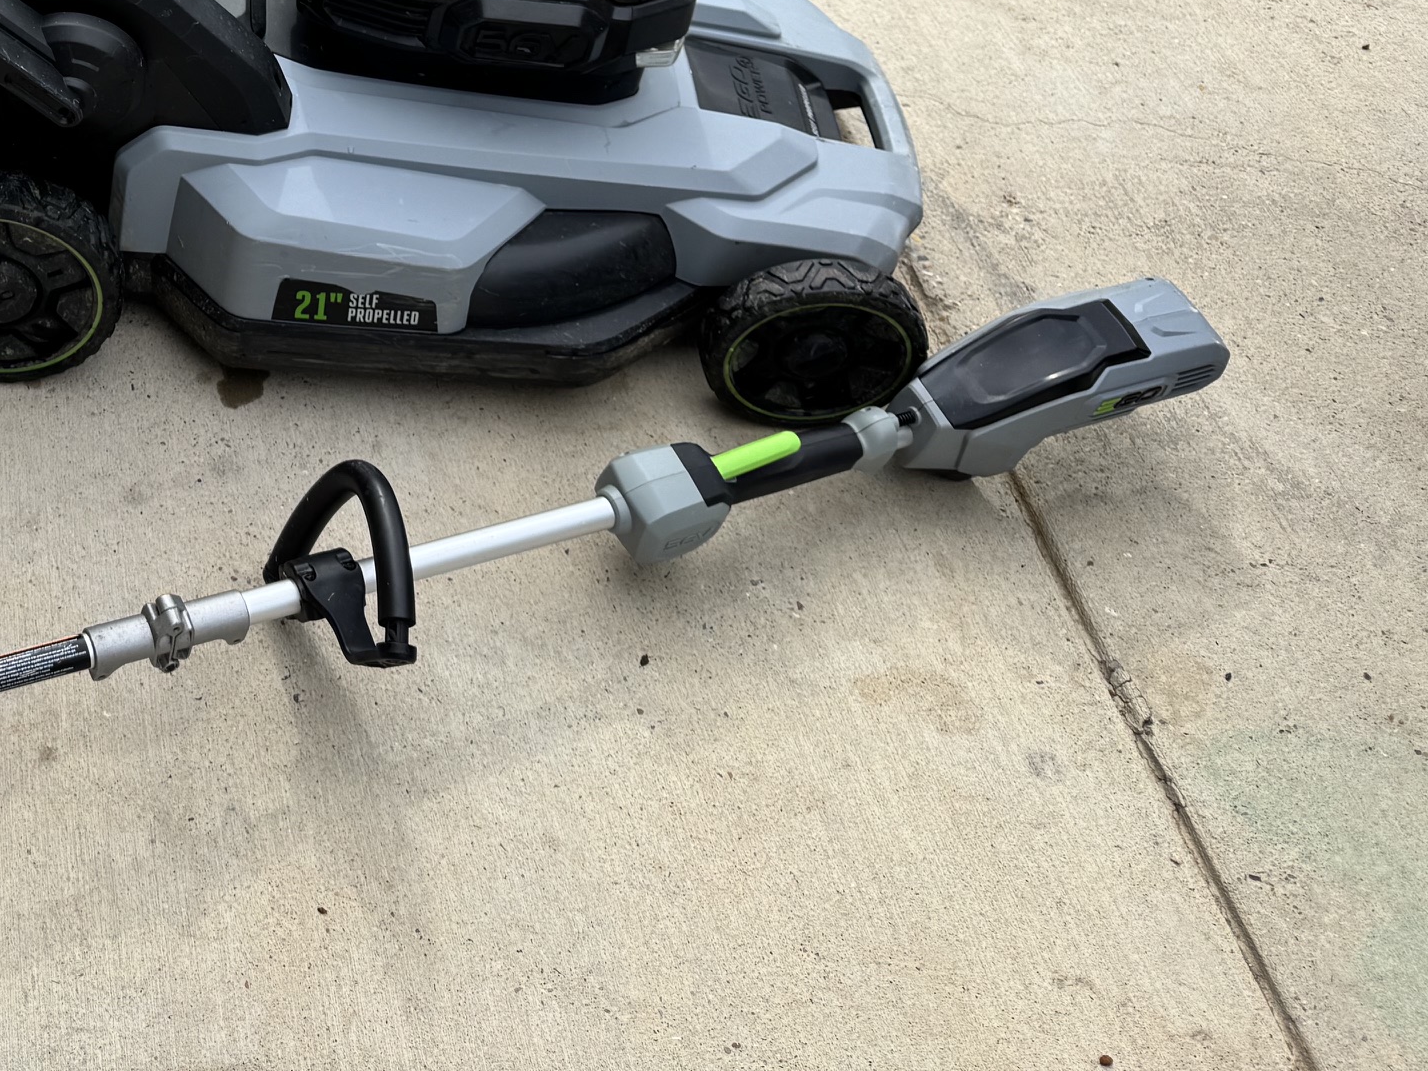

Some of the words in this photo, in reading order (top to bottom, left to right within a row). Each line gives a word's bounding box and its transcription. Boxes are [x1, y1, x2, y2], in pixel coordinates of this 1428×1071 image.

[294, 290, 343, 321] 21"
[349, 293, 380, 309] SELF
[347, 308, 420, 326] PROPELLED
[1093, 386, 1164, 416] EGO
